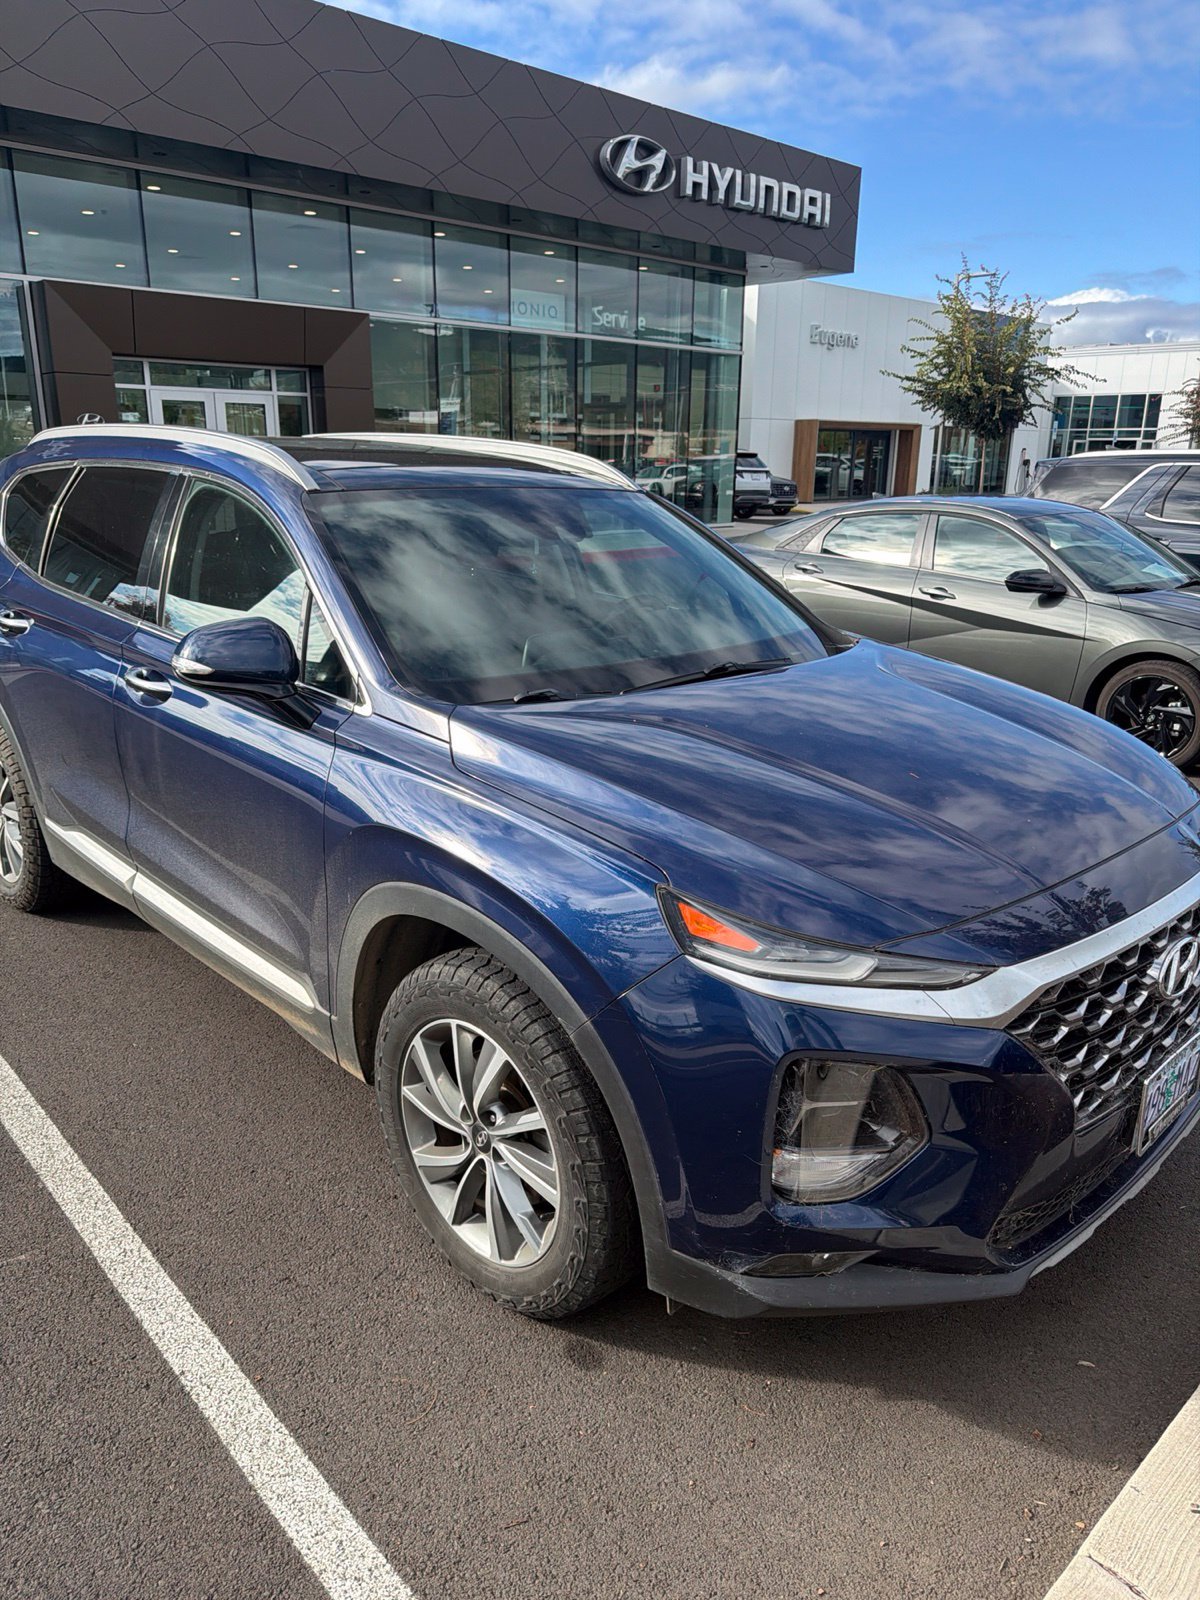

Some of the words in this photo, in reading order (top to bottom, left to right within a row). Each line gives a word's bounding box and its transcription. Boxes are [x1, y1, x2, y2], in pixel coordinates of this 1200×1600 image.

[680, 156, 831, 228] HYUNDAI
[512, 301, 558, 319] IONIQ
[592, 305, 646, 331] Servie
[809, 323, 859, 351] Eugene
